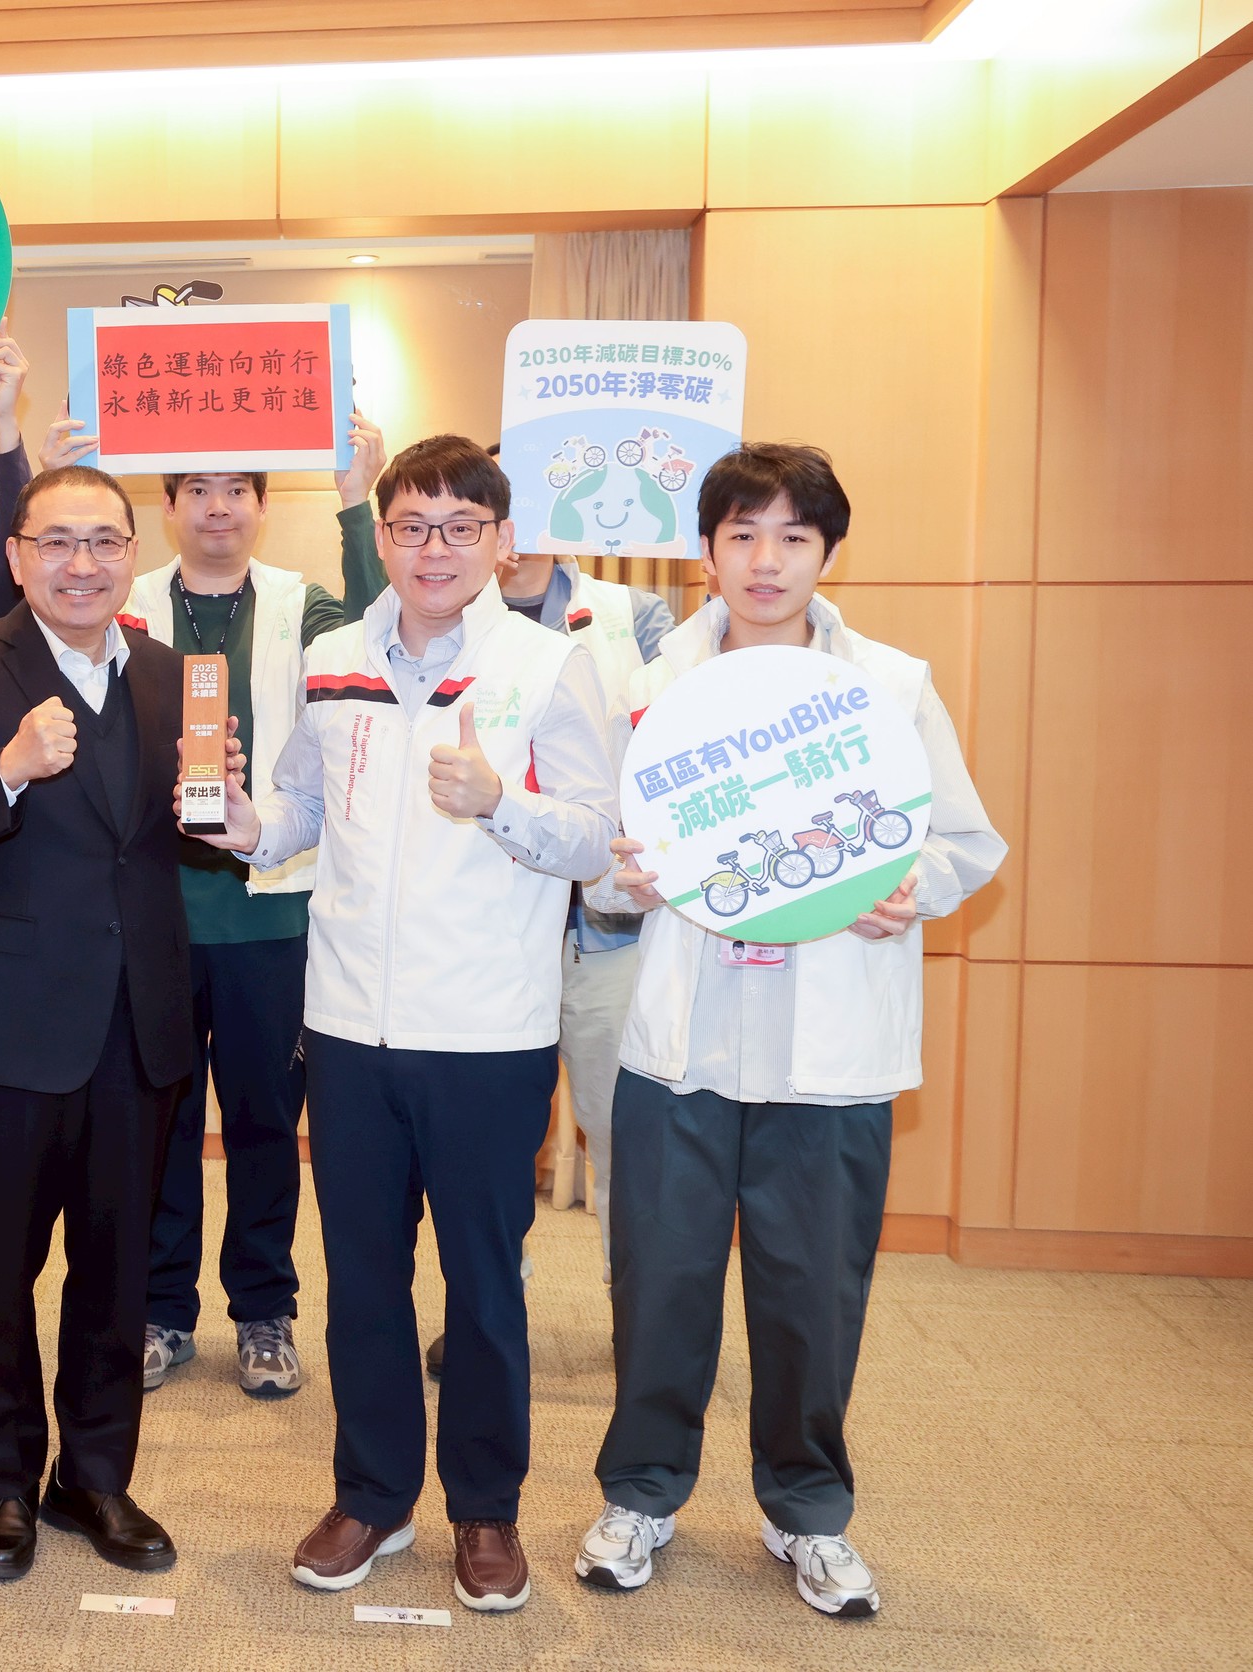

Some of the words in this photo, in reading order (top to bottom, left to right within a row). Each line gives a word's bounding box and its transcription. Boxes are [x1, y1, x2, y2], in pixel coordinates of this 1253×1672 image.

[101, 348, 319, 380] 綠色運輸向前行
[519, 344, 732, 371] 2030年減碳目標30%
[102, 386, 320, 417] 永續新北更前進
[536, 371, 714, 404] 2050年淨零碳
[191, 672, 218, 682] ESG
[192, 664, 217, 672] 2025
[634, 686, 870, 802] 區區有YouBike
[189, 765, 218, 776] ESG
[668, 724, 872, 838] 減碳一騎行
